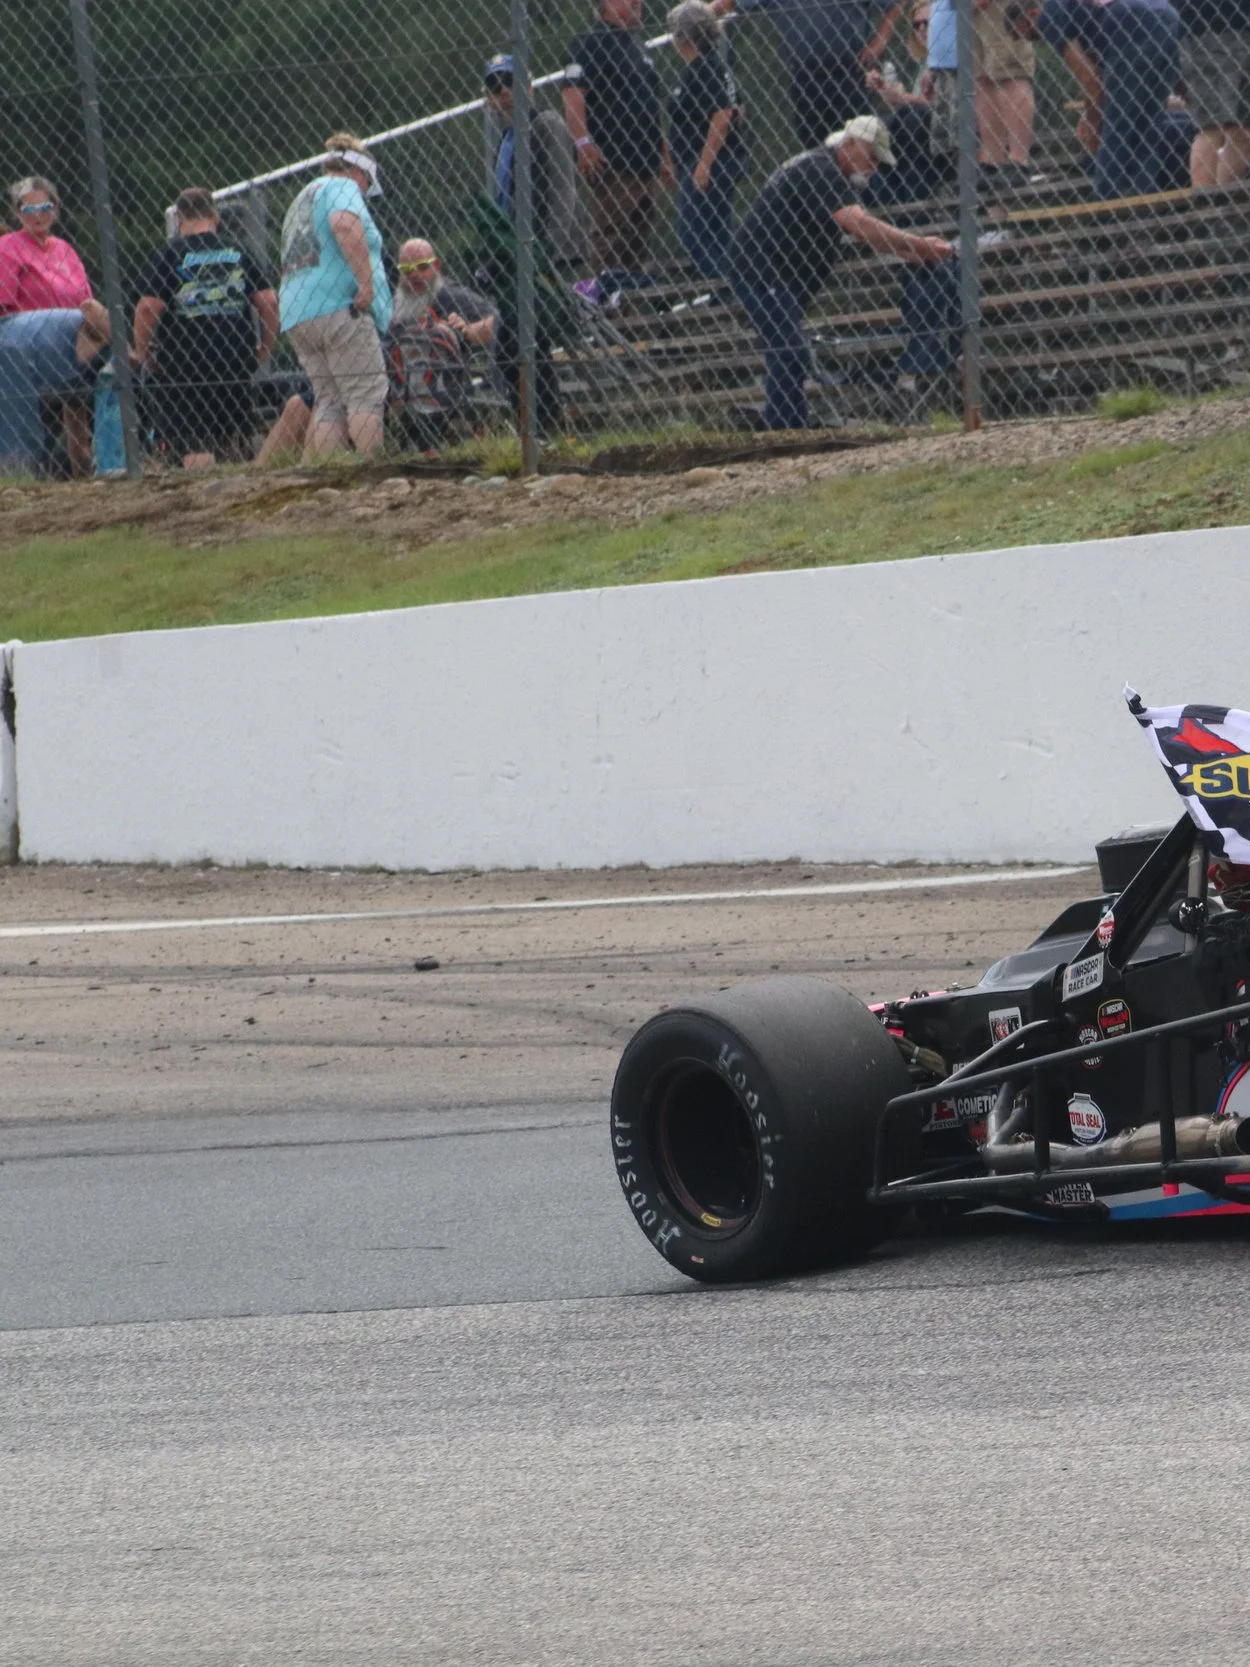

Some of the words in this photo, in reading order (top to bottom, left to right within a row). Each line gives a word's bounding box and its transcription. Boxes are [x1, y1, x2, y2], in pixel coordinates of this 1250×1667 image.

[1070, 958, 1100, 980] NASCAR
[1068, 978, 1085, 993] RACE
[1085, 973, 1098, 986] CAR
[957, 1094, 999, 1115] COMETIC
[1068, 1111, 1086, 1127] TOTAL
[1085, 1113, 1101, 1129] SEAL
[1052, 1188, 1093, 1204] MASTER
